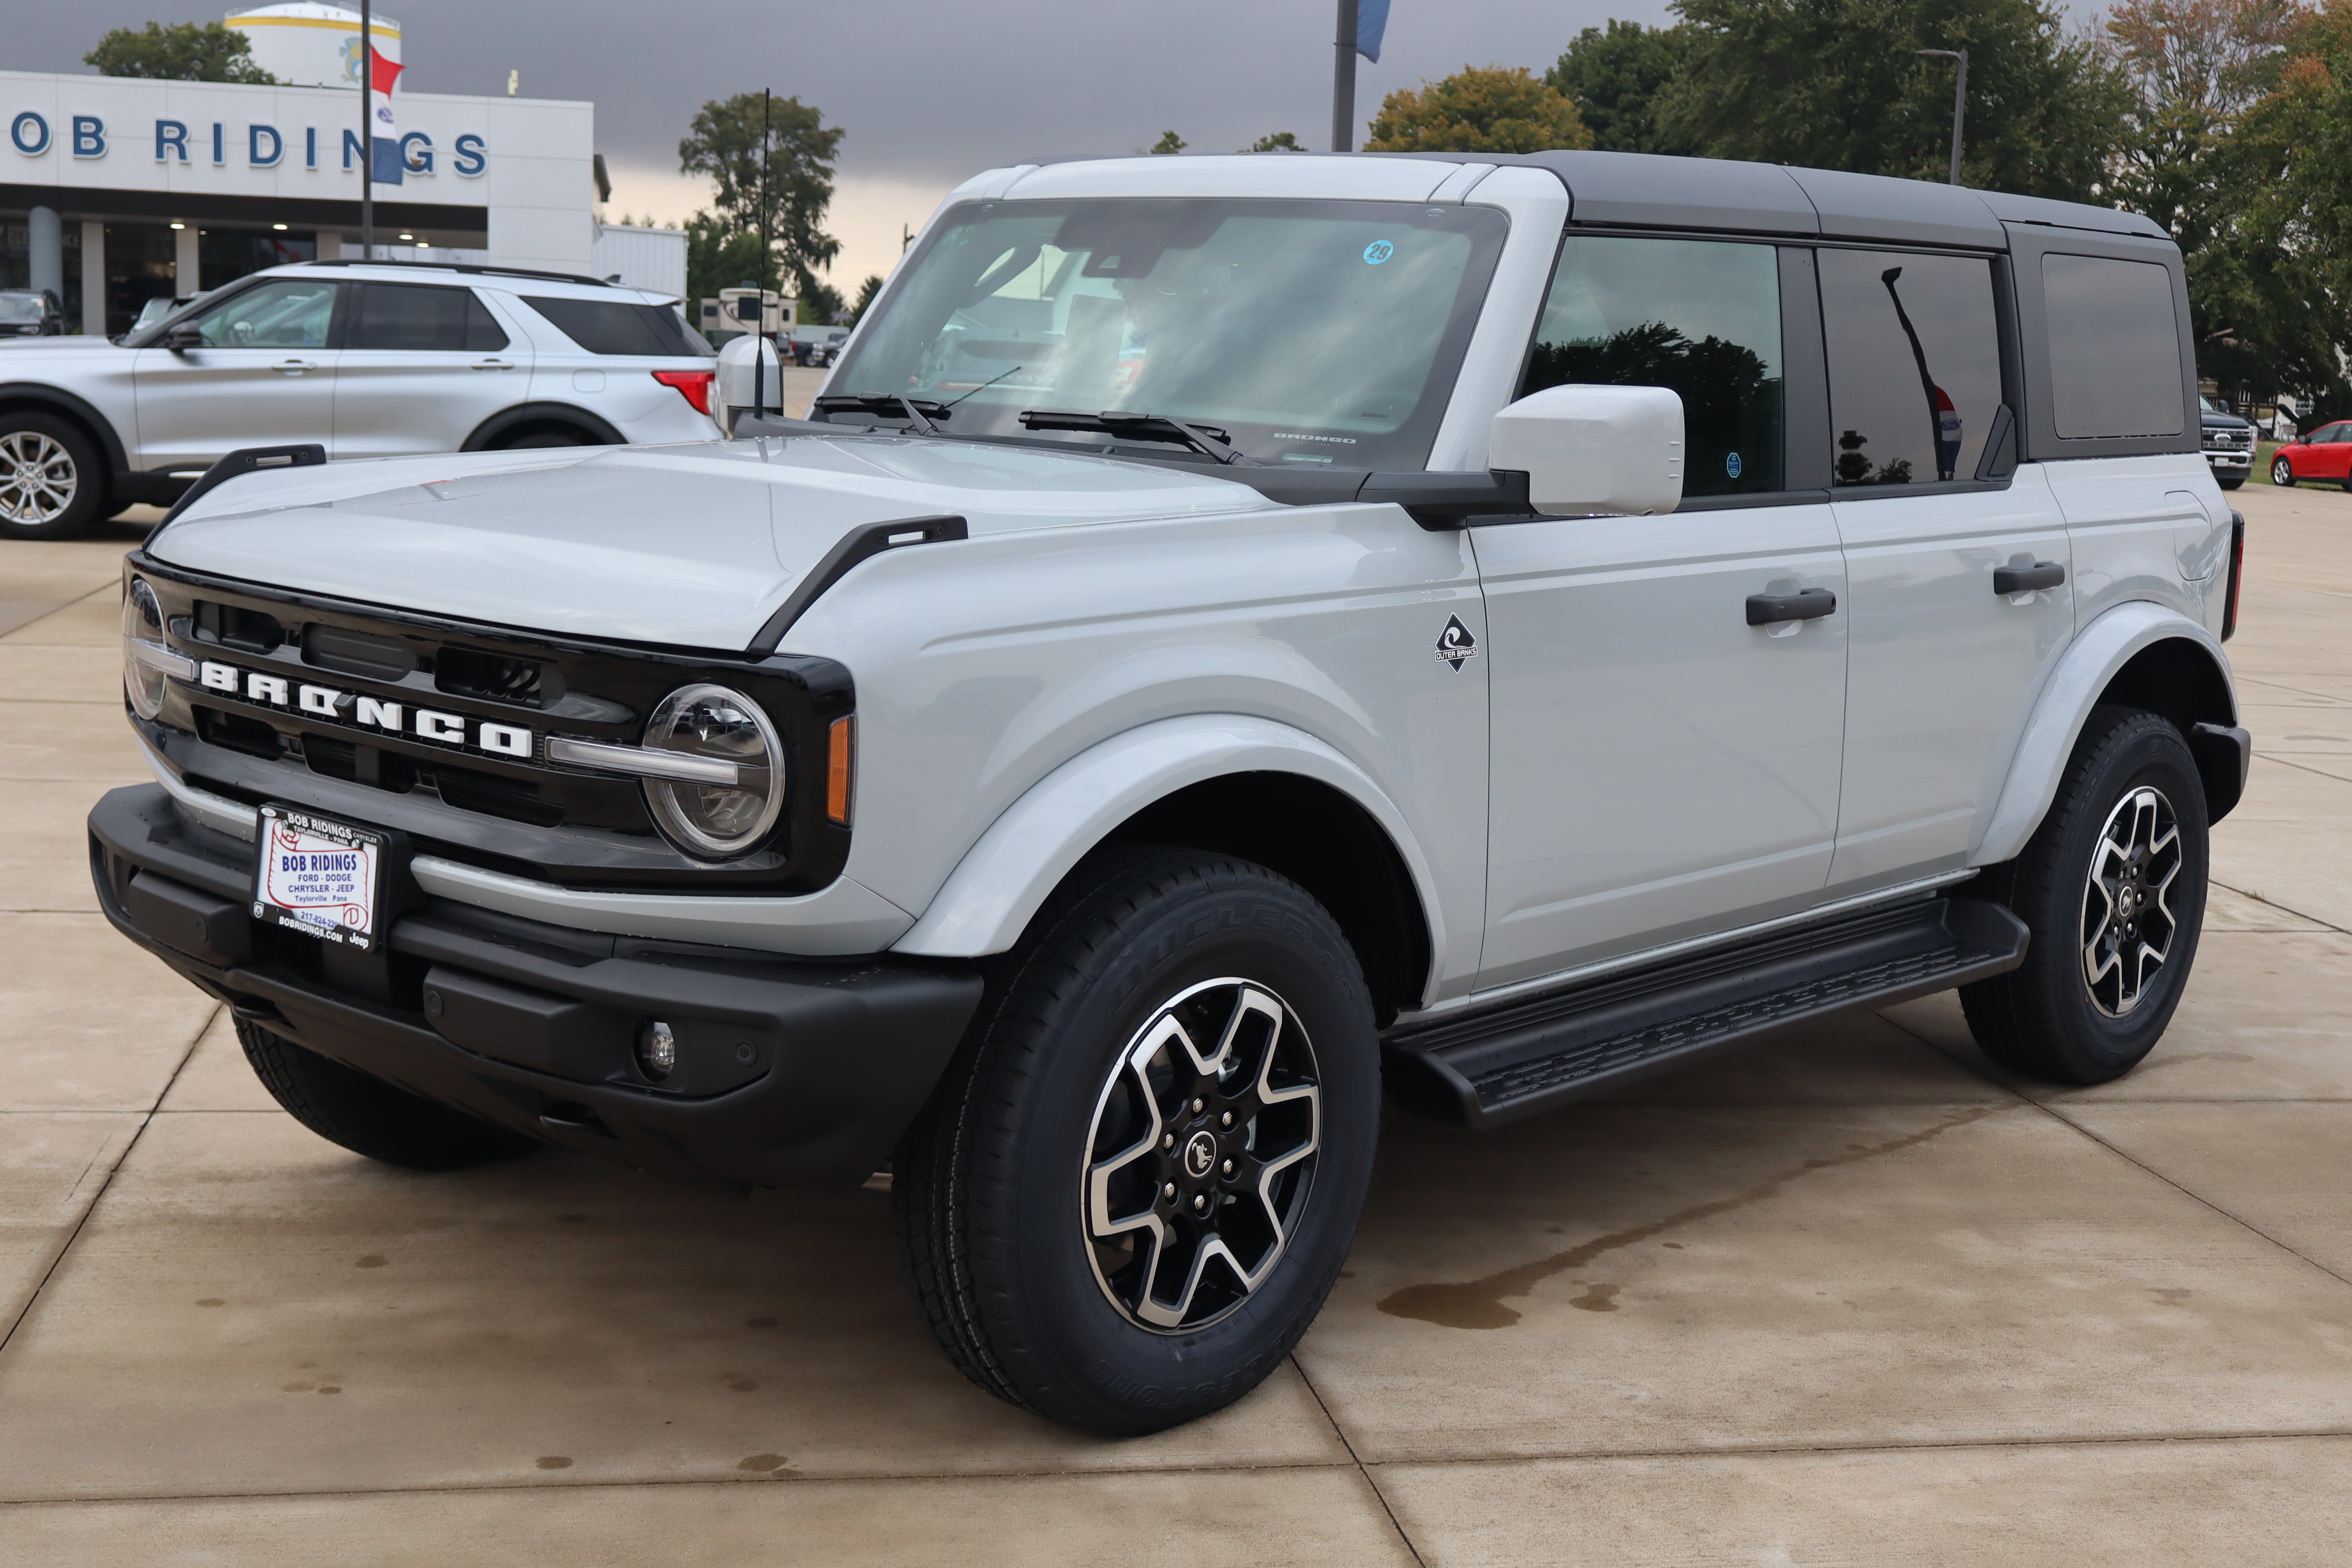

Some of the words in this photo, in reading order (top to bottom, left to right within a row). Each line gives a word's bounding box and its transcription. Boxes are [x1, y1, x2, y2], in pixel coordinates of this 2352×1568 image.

[1366, 244, 1391, 260] 29
[1274, 433, 1356, 444] BRONCO
[1437, 651, 1455, 660] OUTER
[1457, 648, 1476, 657] BANKS
[201, 661, 532, 758] BRONCO
[287, 813, 309, 828] BOB
[312, 820, 352, 840] RIDINGS
[294, 826, 329, 840] TAYLORVILLE
[333, 836, 348, 846] PANA
[283, 855, 307, 871] BOB
[312, 854, 356, 871] RIDINGS
[279, 916, 343, 943] BOBRIDINGS.COM
[349, 932, 369, 949] Jeep
[1082, 1241, 1341, 1410] BRIDGESTONE
